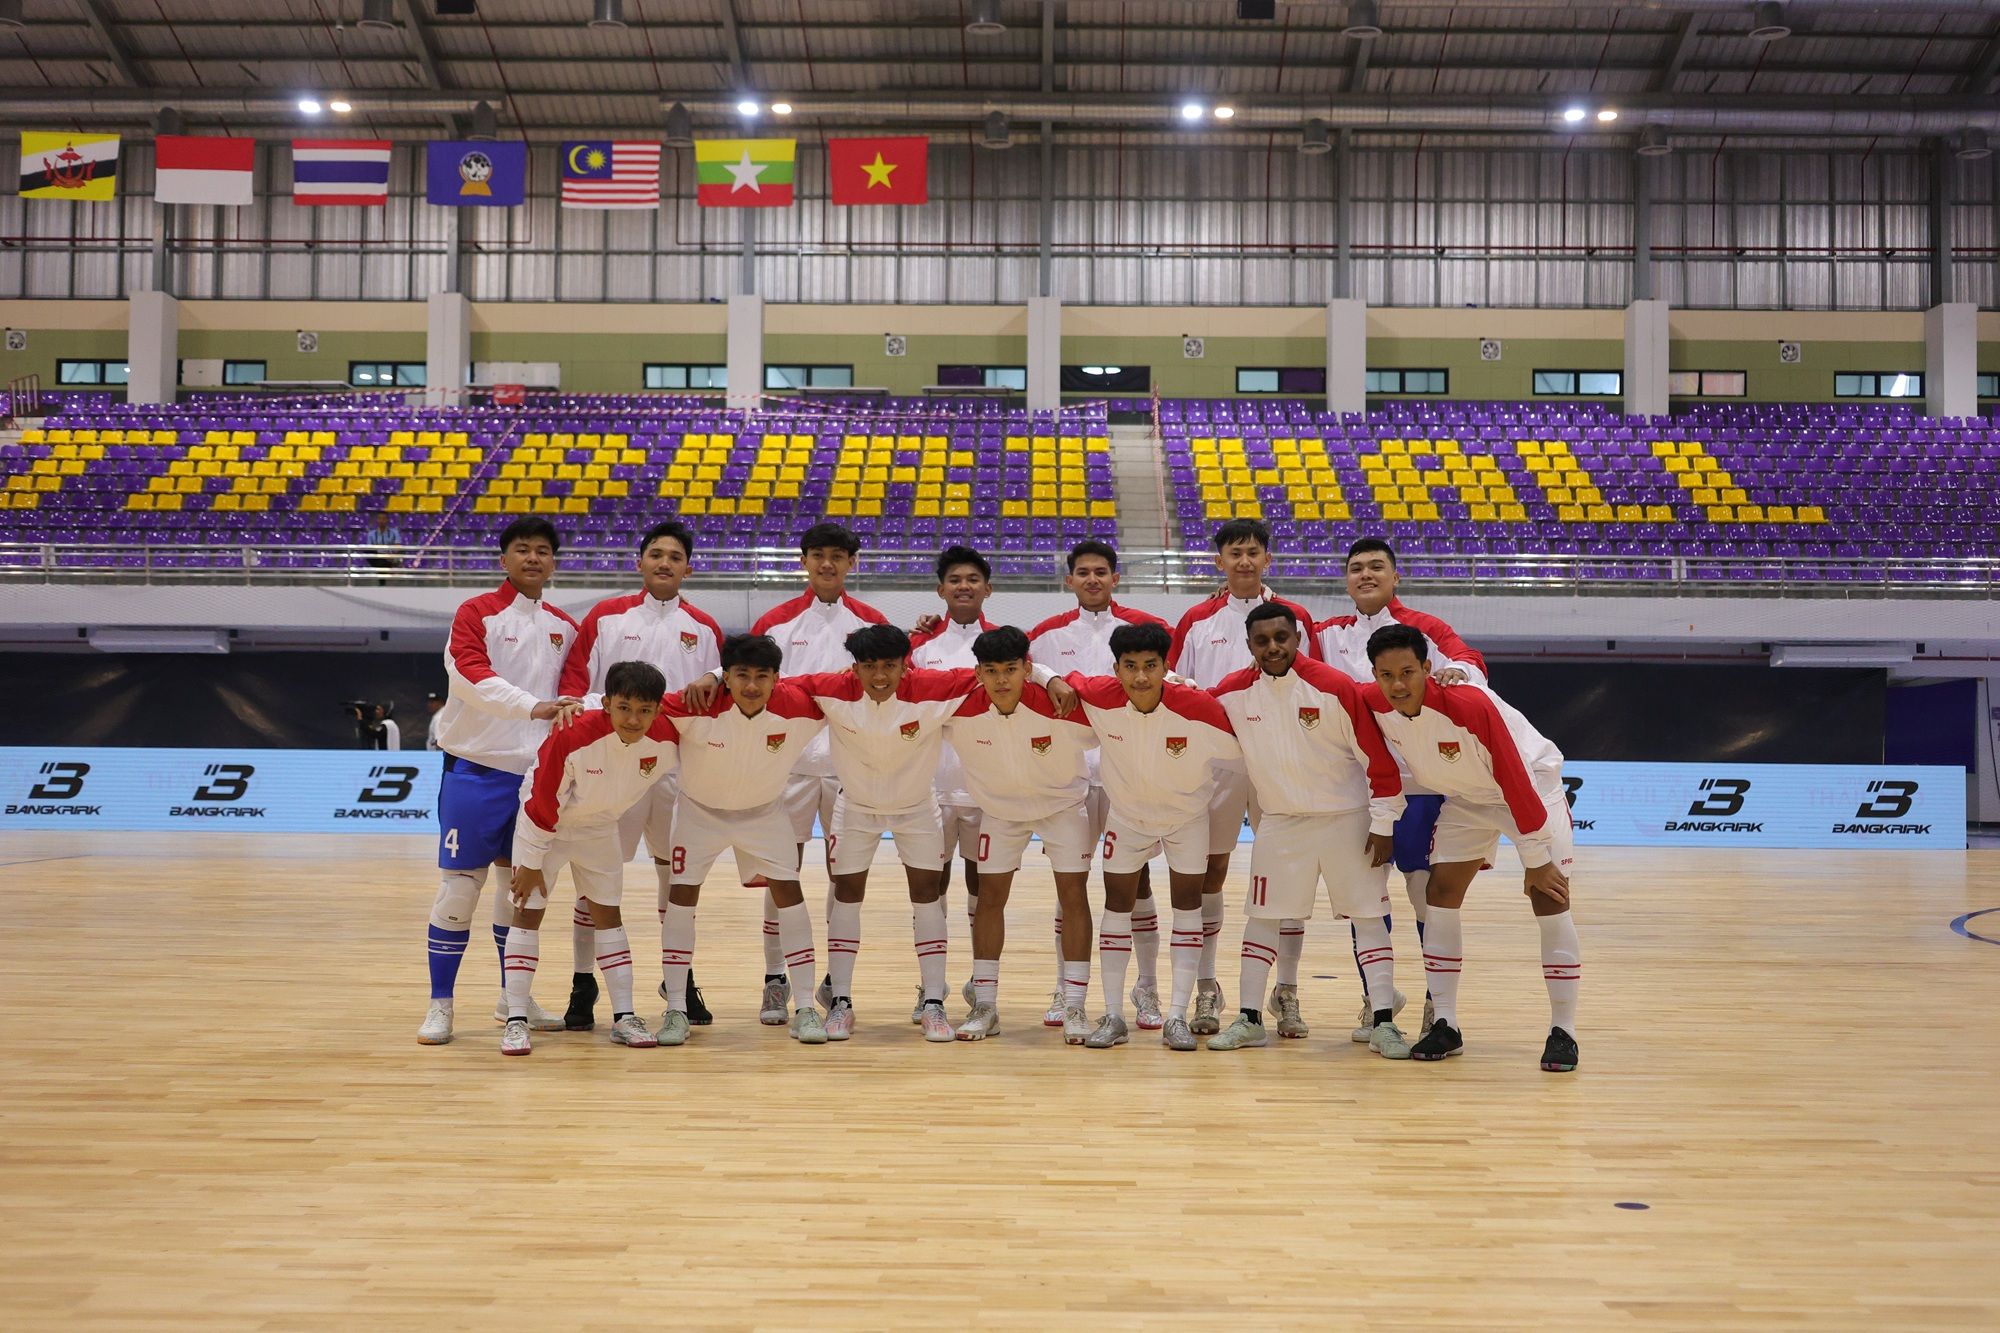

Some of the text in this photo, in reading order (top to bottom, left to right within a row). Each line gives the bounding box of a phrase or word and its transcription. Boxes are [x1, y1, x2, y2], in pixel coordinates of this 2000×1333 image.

[1191, 437, 1827, 523] HALL
[5, 805, 102, 816] BANGKRIRK
[170, 806, 267, 818] BANGKRIRK
[334, 809, 431, 819] BANGKRIRK
[1664, 821, 1764, 832] BANGKRIRK
[1832, 823, 1932, 834] BANGKRIRK
[444, 828, 460, 858] 4
[1103, 830, 1117, 860] 6
[672, 846, 687, 875] 8
[1253, 875, 1268, 907] 11
